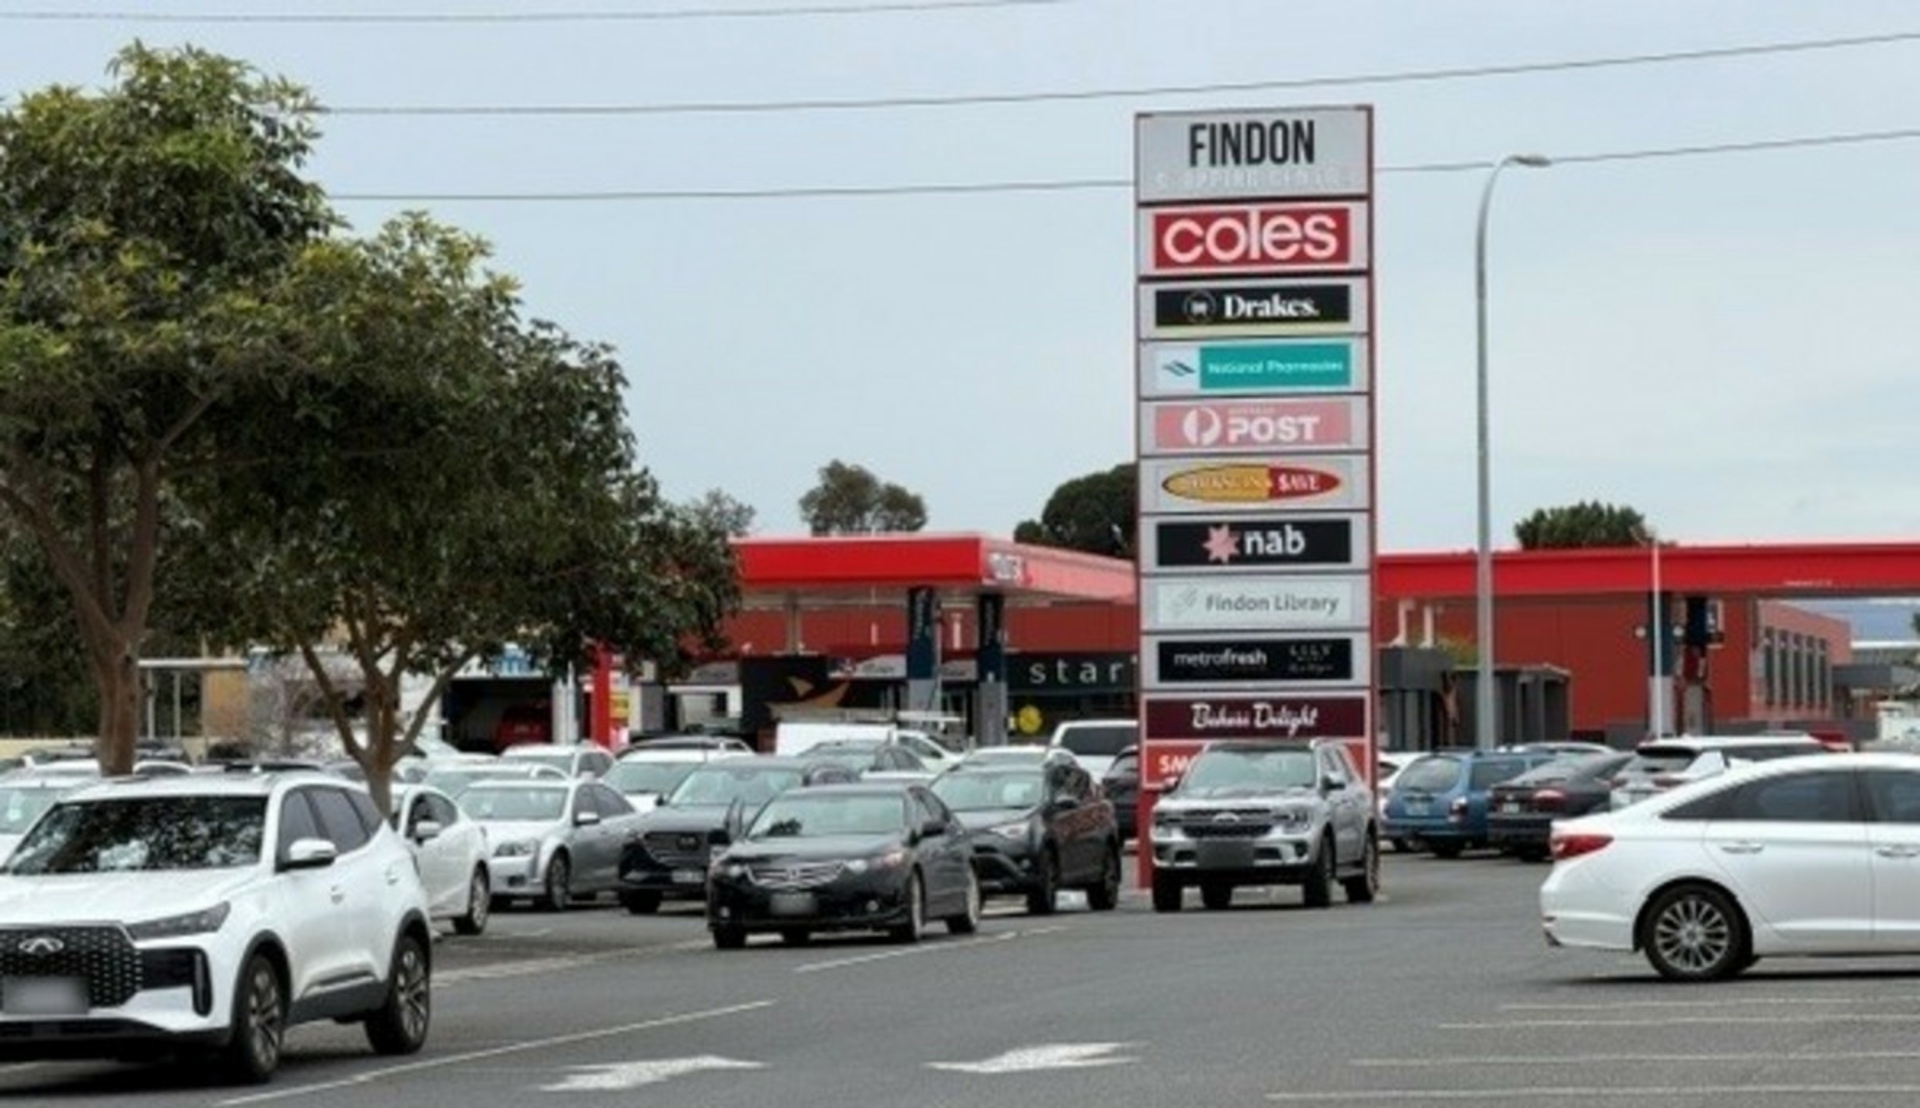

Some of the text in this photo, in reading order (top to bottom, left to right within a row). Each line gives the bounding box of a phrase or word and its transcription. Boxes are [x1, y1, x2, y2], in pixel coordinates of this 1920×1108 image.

[1189, 120, 1315, 167] FINDON
[1163, 210, 1338, 263] coles
[1227, 415, 1320, 443] POST
[1244, 523, 1306, 556] nab
[1205, 593, 1340, 616] Findon Library
[1174, 649, 1267, 667] metrofresh
